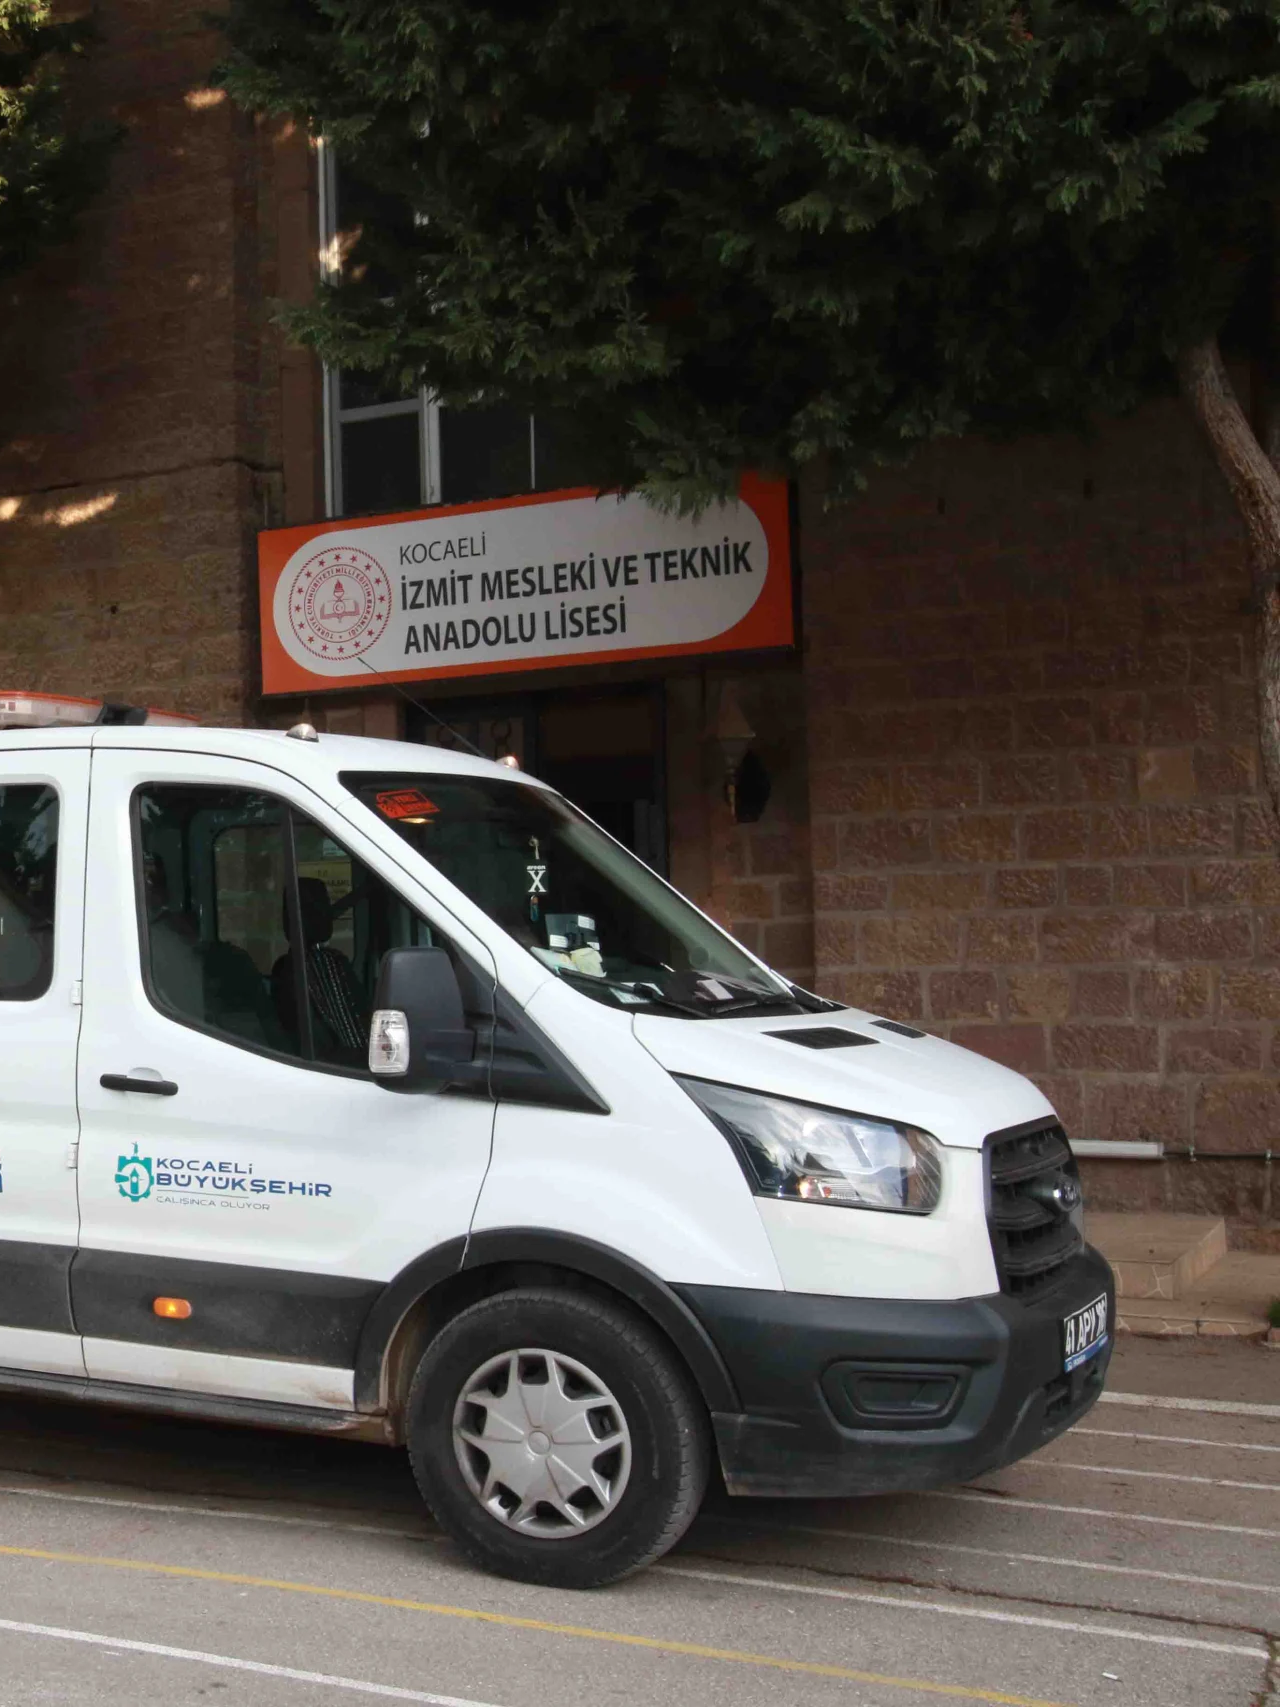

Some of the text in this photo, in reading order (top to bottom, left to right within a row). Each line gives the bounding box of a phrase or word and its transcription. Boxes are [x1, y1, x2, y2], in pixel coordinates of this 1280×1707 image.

[399, 531, 486, 565] KOCAELİ
[401, 537, 753, 611] İZMİT MESLEKİ VE TEKNİK
[404, 596, 628, 655] ANADOLU LİSESİ
[527, 870, 547, 892] X
[156, 1172, 332, 1198] BÜYÜKŞEHİR
[220, 1201, 270, 1210] OLUYOR
[1065, 1319, 1075, 1355] 41
